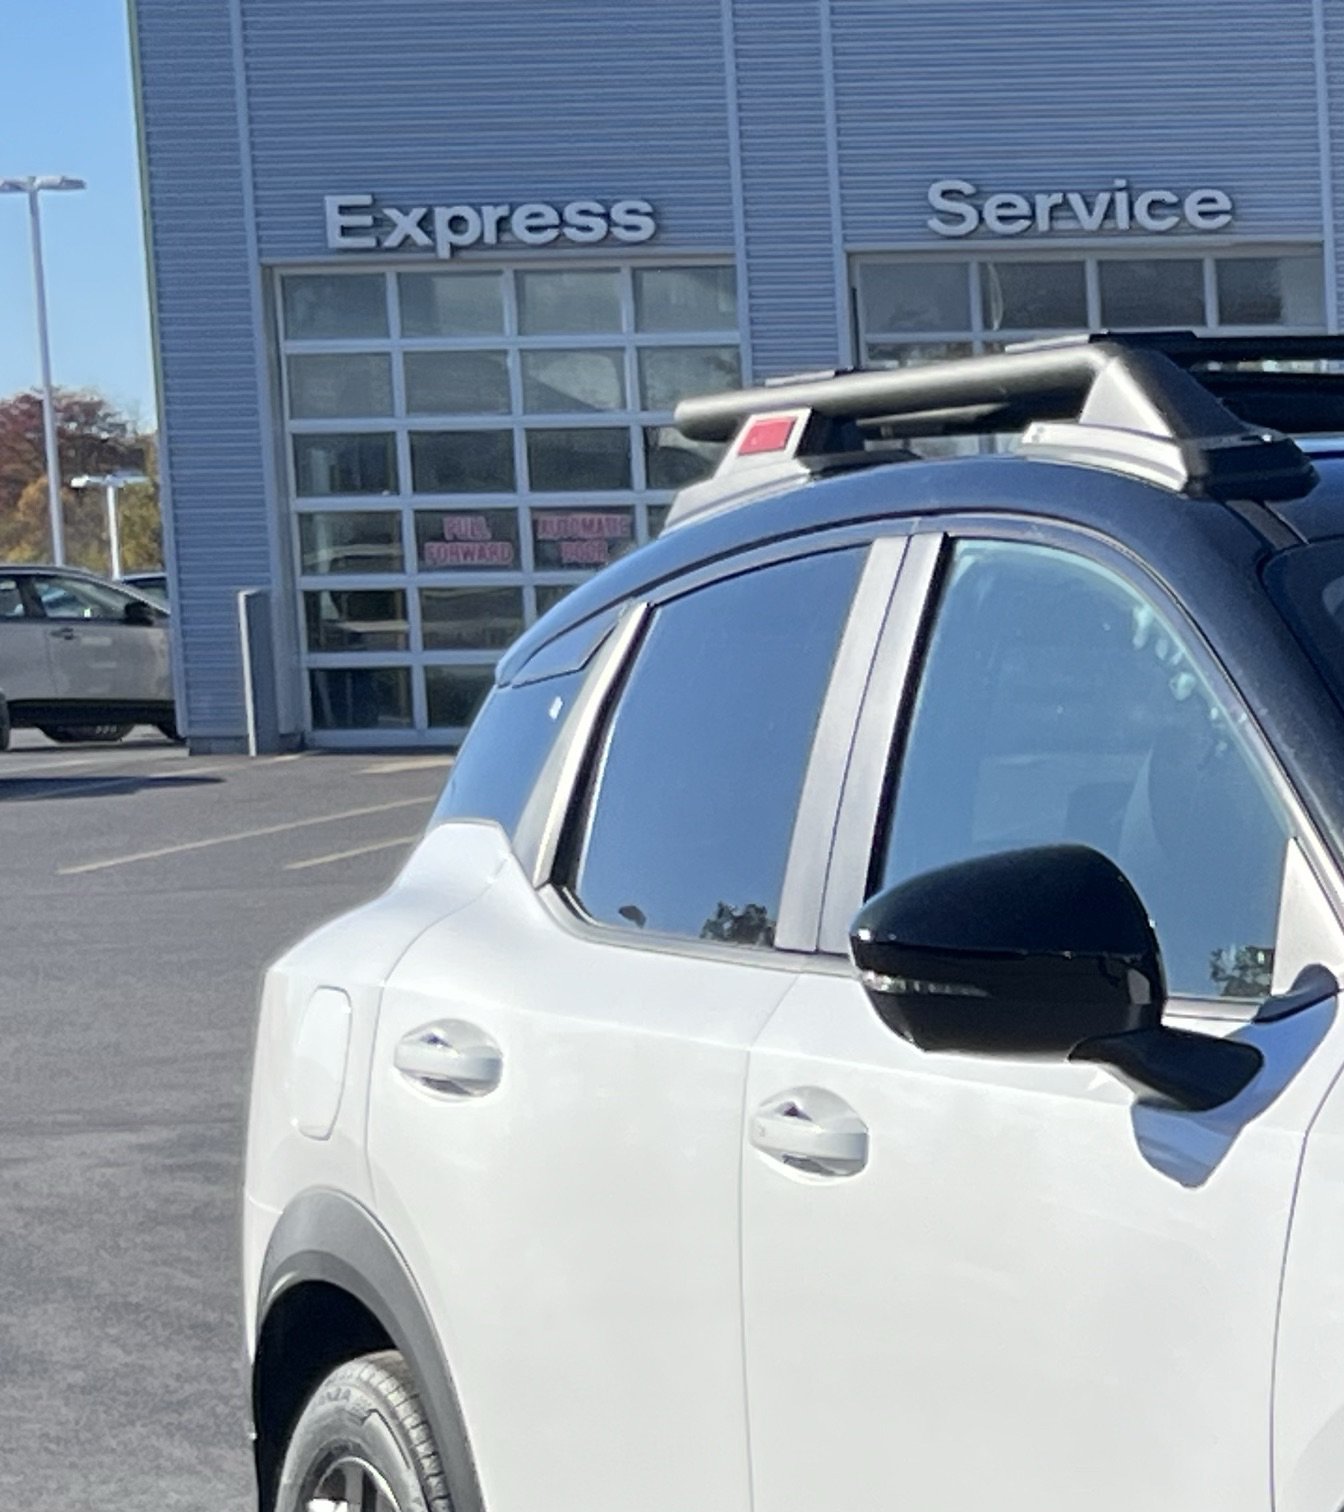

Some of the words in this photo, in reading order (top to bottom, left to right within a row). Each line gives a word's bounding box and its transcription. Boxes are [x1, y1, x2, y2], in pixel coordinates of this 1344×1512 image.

[323, 193, 657, 260] Express
[926, 177, 1234, 238] Service
[424, 541, 513, 566] FORWARD
